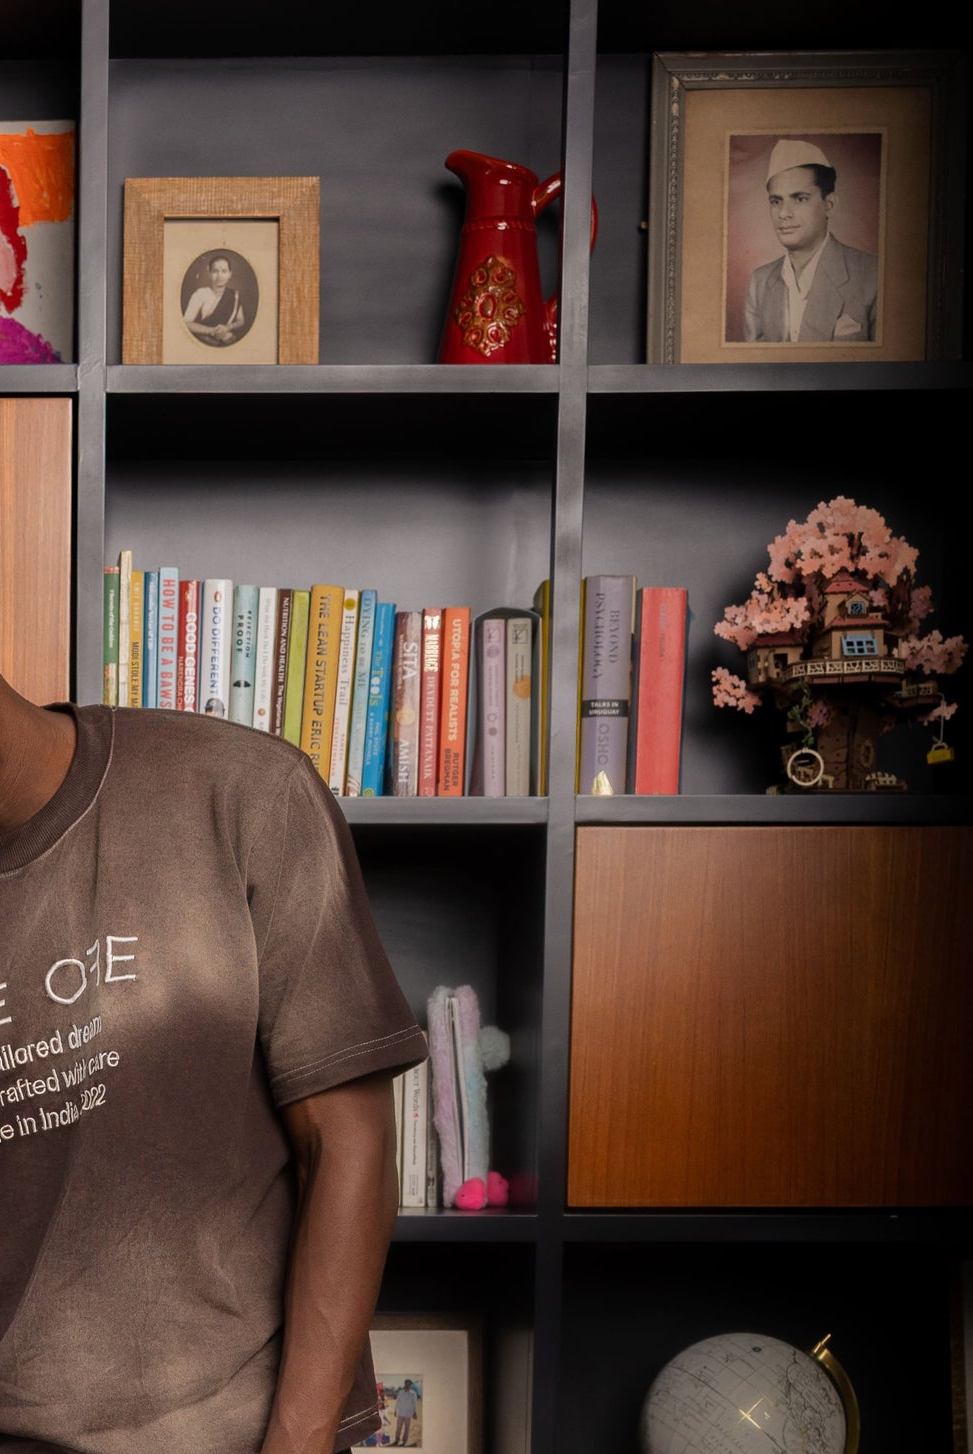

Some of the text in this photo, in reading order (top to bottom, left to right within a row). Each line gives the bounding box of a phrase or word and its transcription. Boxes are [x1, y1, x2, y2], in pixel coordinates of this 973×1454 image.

[185, 612, 197, 653] GOOD
[236, 615, 244, 653] PROOF
[280, 597, 290, 636] NUTRITION
[361, 598, 373, 638] DYING
[592, 593, 605, 679] PSYCHOLOGY
[609, 610, 620, 664] BEYOND
[160, 580, 175, 708] HOW TO BE A BAWS
[210, 607, 222, 695] DO DIFFERENT
[279, 638, 287, 654] AND
[338, 616, 355, 706] Happiness Trail
[375, 650, 383, 666] The
[403, 642, 418, 680] SITA
[131, 642, 139, 696] MODI STOLE MY
[184, 656, 196, 701] GENES
[278, 655, 286, 682] HEALTH
[310, 594, 332, 750] THE LEAN STARTUP ERIC
[357, 671, 366, 690] ME
[370, 667, 384, 706] Tools
[448, 619, 462, 741] UTOPIA FOR REALISTS
[426, 676, 435, 723] DEVDUTT
[398, 738, 410, 782] AMISH
[423, 726, 433, 779] PATTANAIK
[597, 723, 610, 765] OSHO
[444, 748, 452, 791] BREGMAN
[452, 753, 460, 786] RUTGER
[68, 1015, 102, 1050] dream
[88, 1050, 120, 1078] care
[17, 1115, 37, 1136] in
[80, 1083, 106, 1111] 2022
